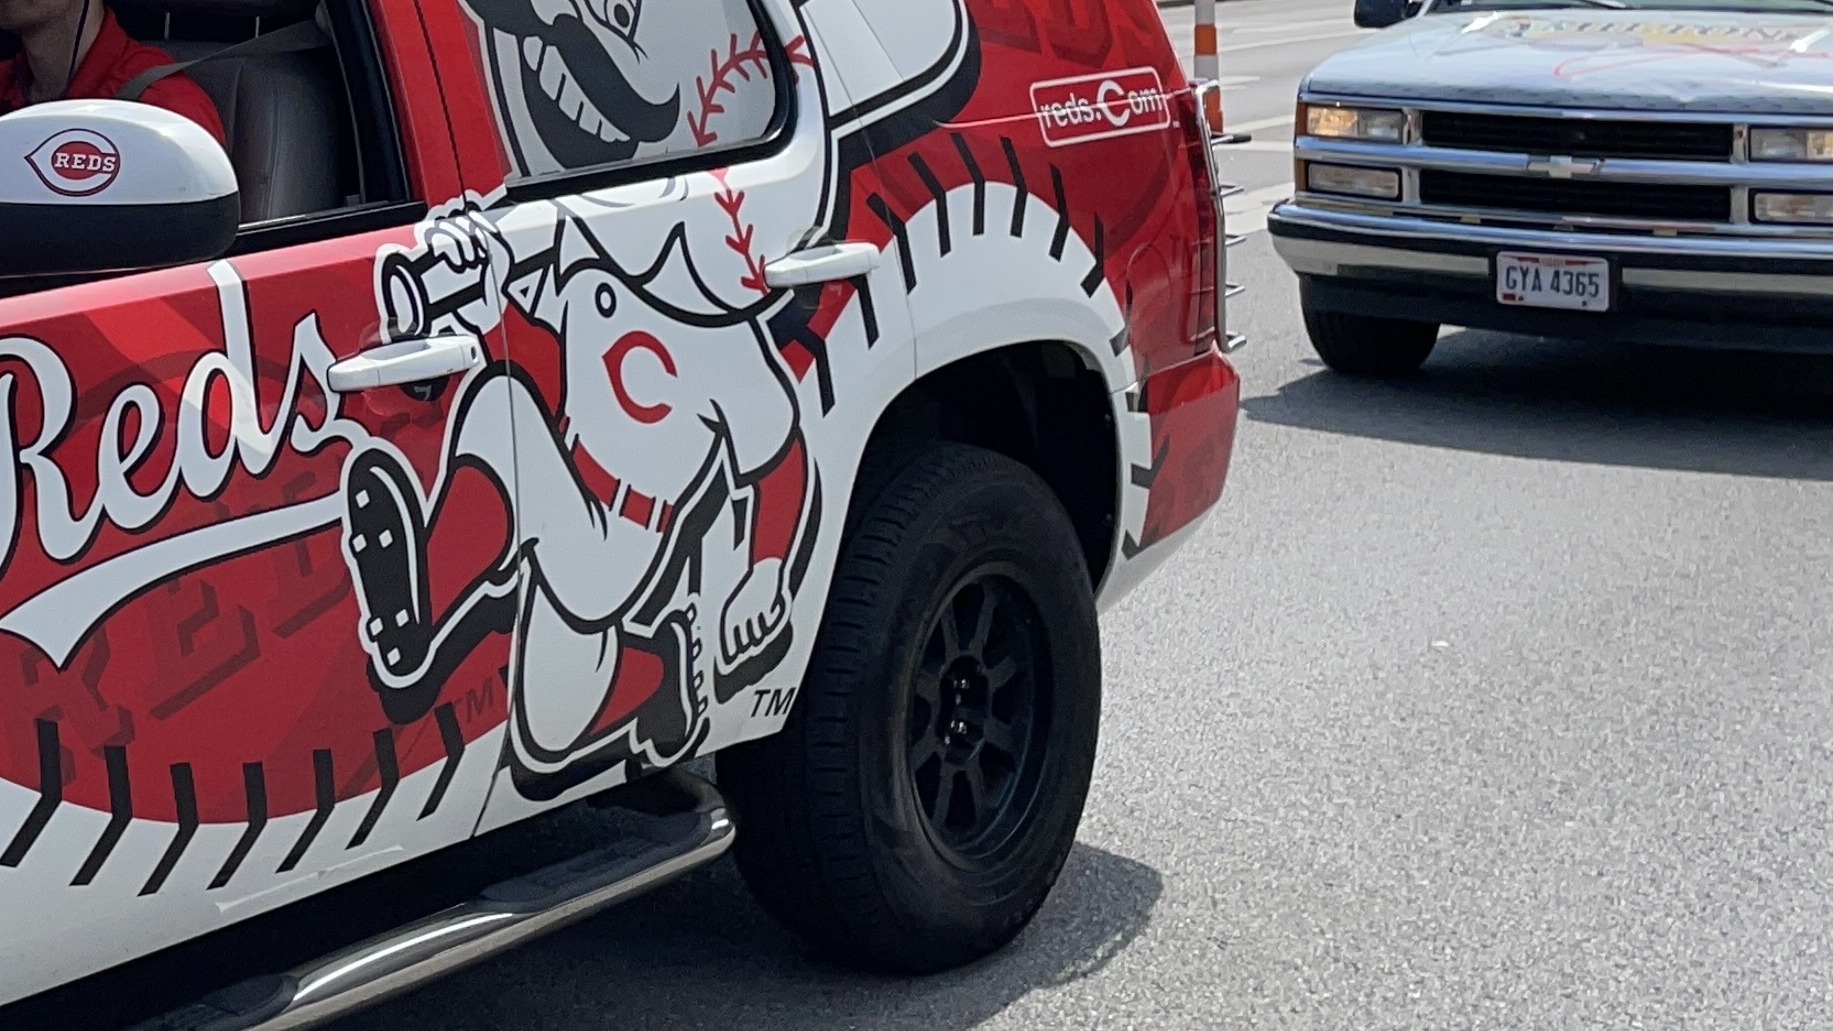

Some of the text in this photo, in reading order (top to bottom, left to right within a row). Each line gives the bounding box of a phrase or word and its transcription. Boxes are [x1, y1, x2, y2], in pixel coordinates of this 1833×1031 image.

[54, 152, 116, 172] REDS
[1506, 265, 1600, 298] GYA 4365
[601, 330, 678, 424] C
[750, 687, 796, 718] TM
